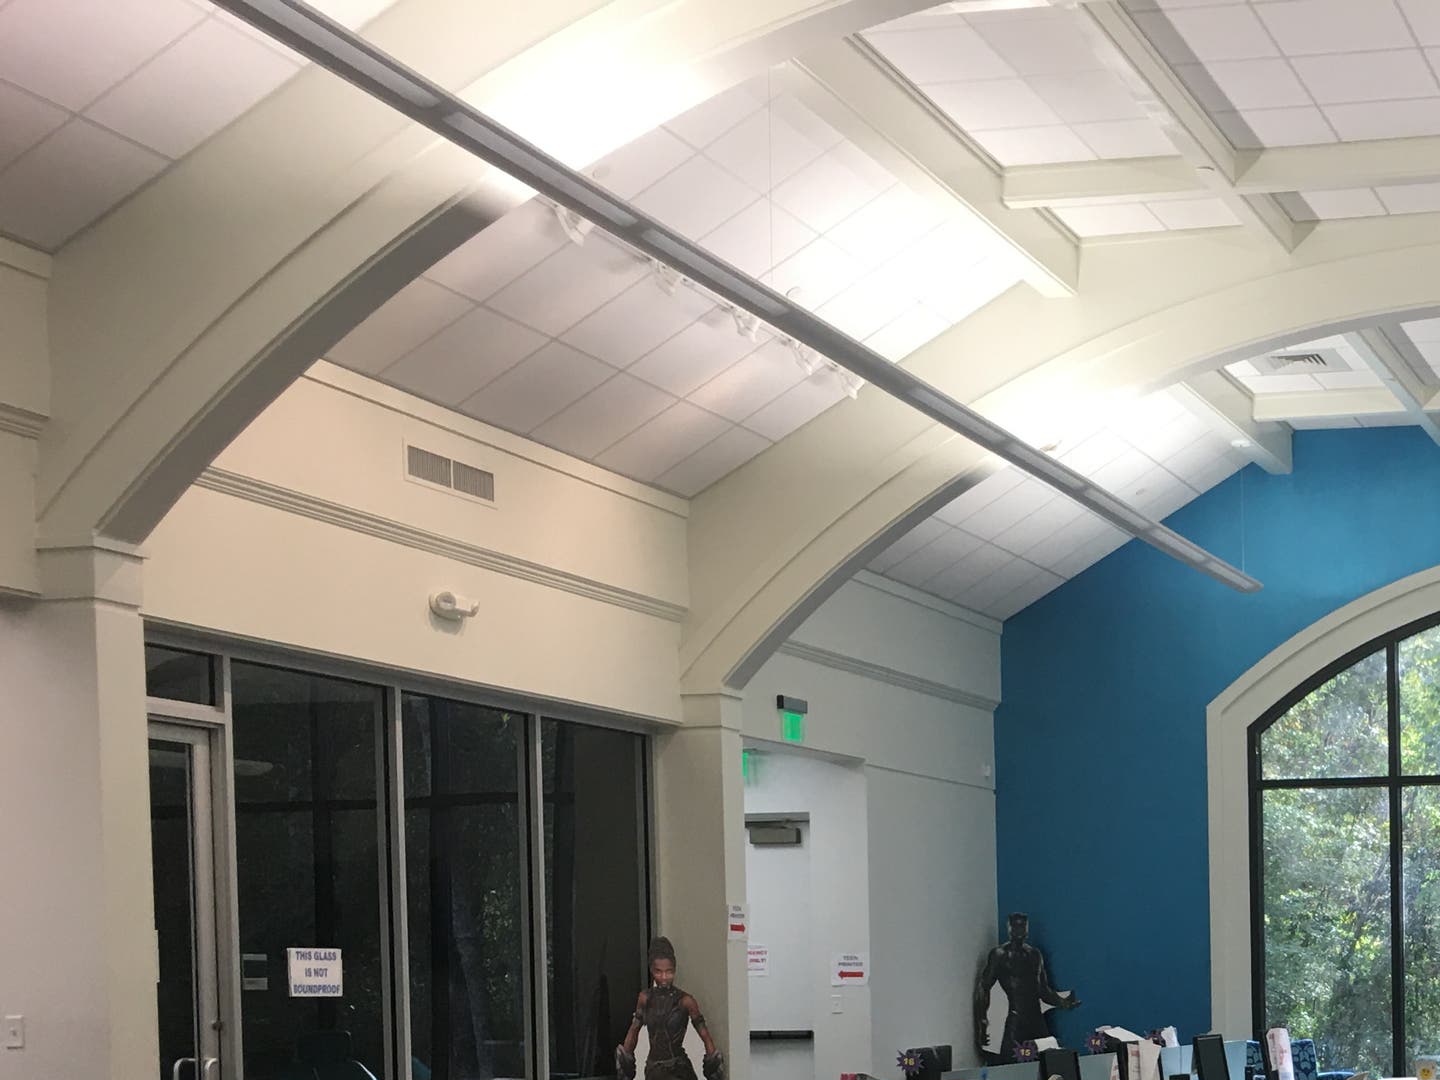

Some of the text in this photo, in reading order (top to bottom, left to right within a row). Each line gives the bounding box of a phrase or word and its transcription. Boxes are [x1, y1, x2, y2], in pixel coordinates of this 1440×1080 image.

[296, 951, 336, 961] THIS GLASS
[305, 968, 328, 977] IS NOT
[294, 984, 340, 994] SOUNDPROOF
